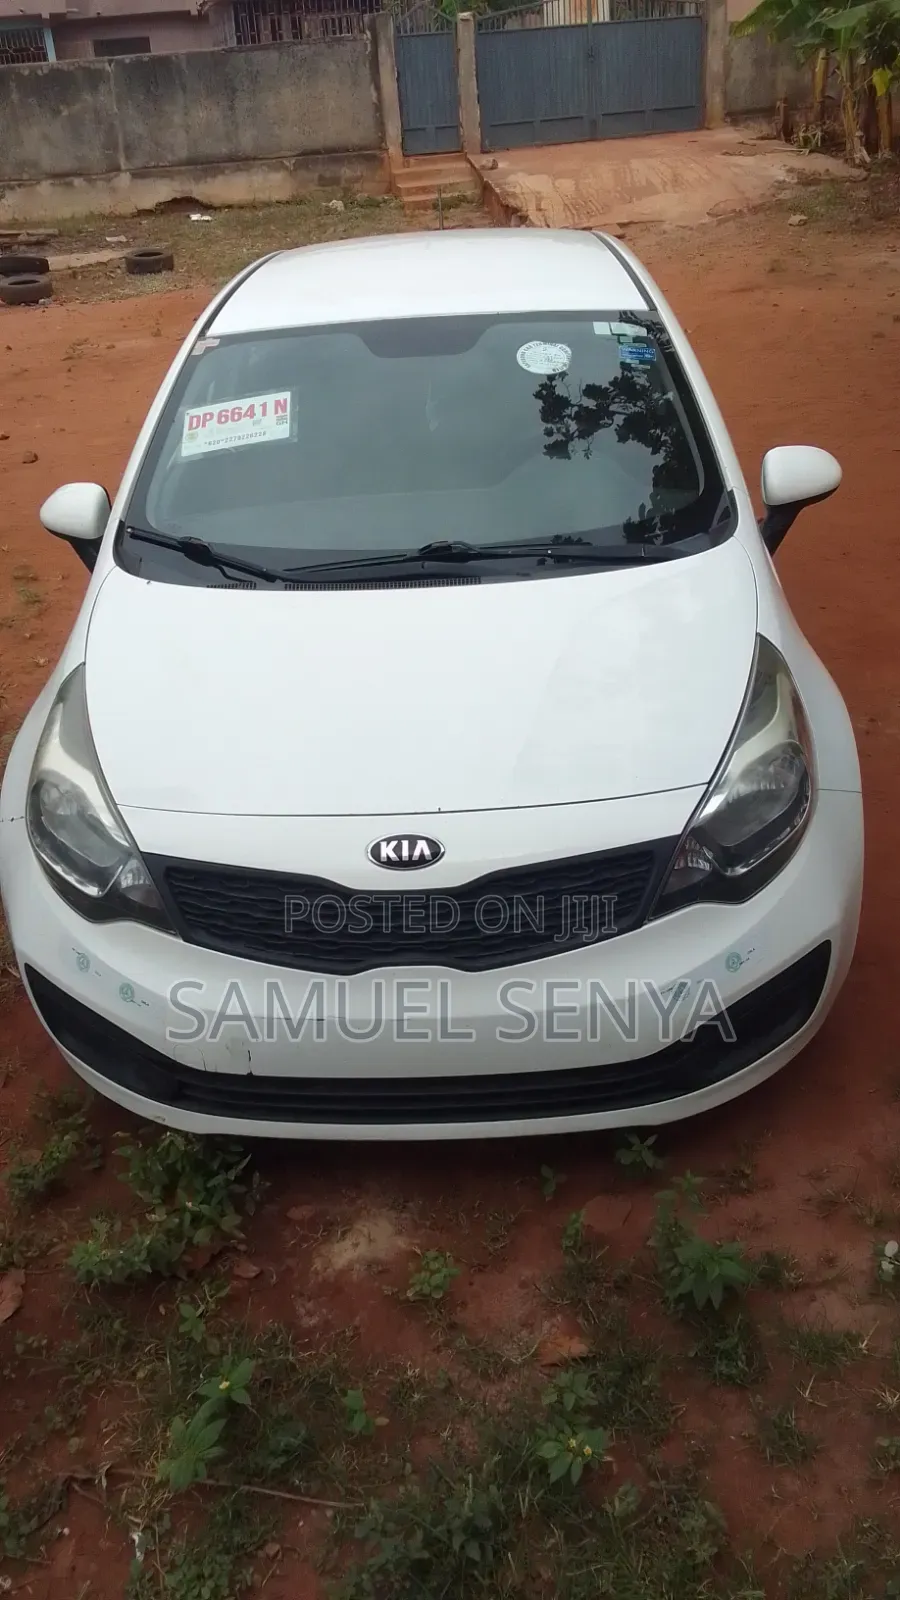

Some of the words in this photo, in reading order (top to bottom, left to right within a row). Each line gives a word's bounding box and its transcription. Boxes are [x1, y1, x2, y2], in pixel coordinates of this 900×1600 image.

[188, 412, 214, 430] DP
[217, 402, 267, 424] 6641
[274, 398, 288, 415] N
[379, 839, 433, 862] KIA
